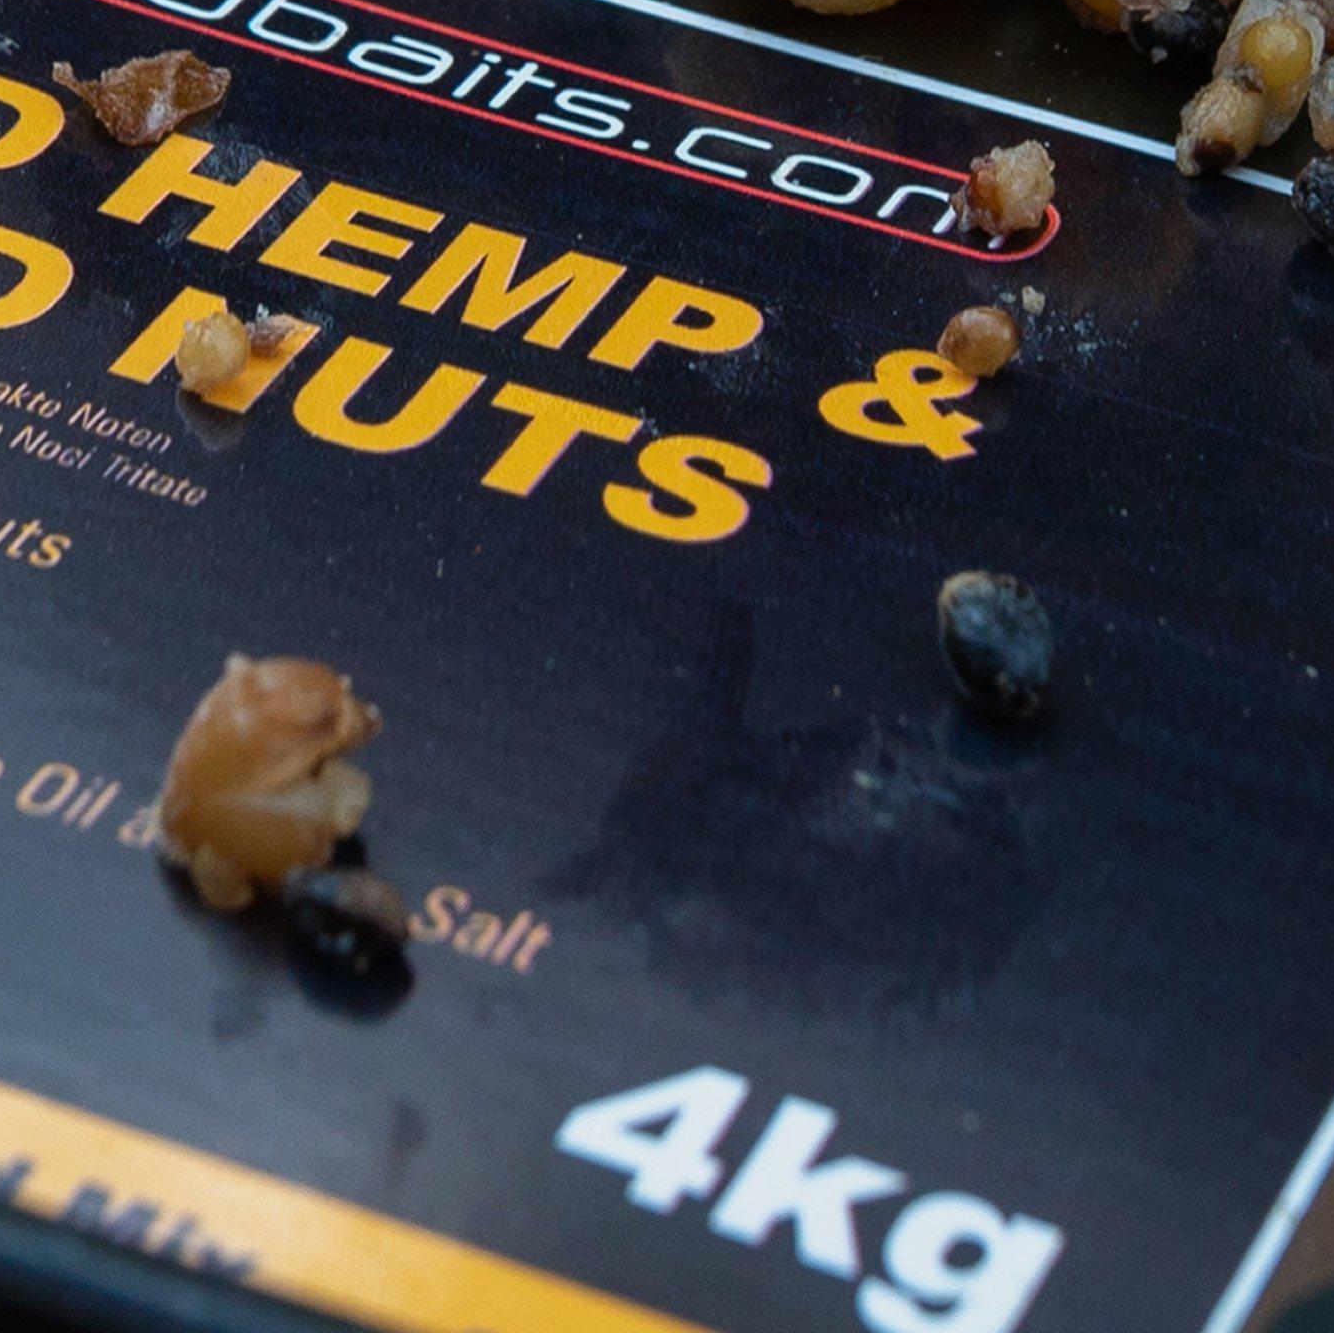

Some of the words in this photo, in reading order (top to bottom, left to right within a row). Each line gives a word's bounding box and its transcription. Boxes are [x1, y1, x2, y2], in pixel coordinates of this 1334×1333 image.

[98, 133, 764, 371] HEMP
[818, 348, 985, 461] &
[108, 284, 773, 542] NUTS
[10, 424, 98, 470] Noci
[103, 452, 208, 507] Tritate
[68, 402, 173, 454] Noten
[15, 760, 120, 828] Oil
[407, 884, 552, 974] Salt
[554, 1063, 1065, 1333] 4kg
